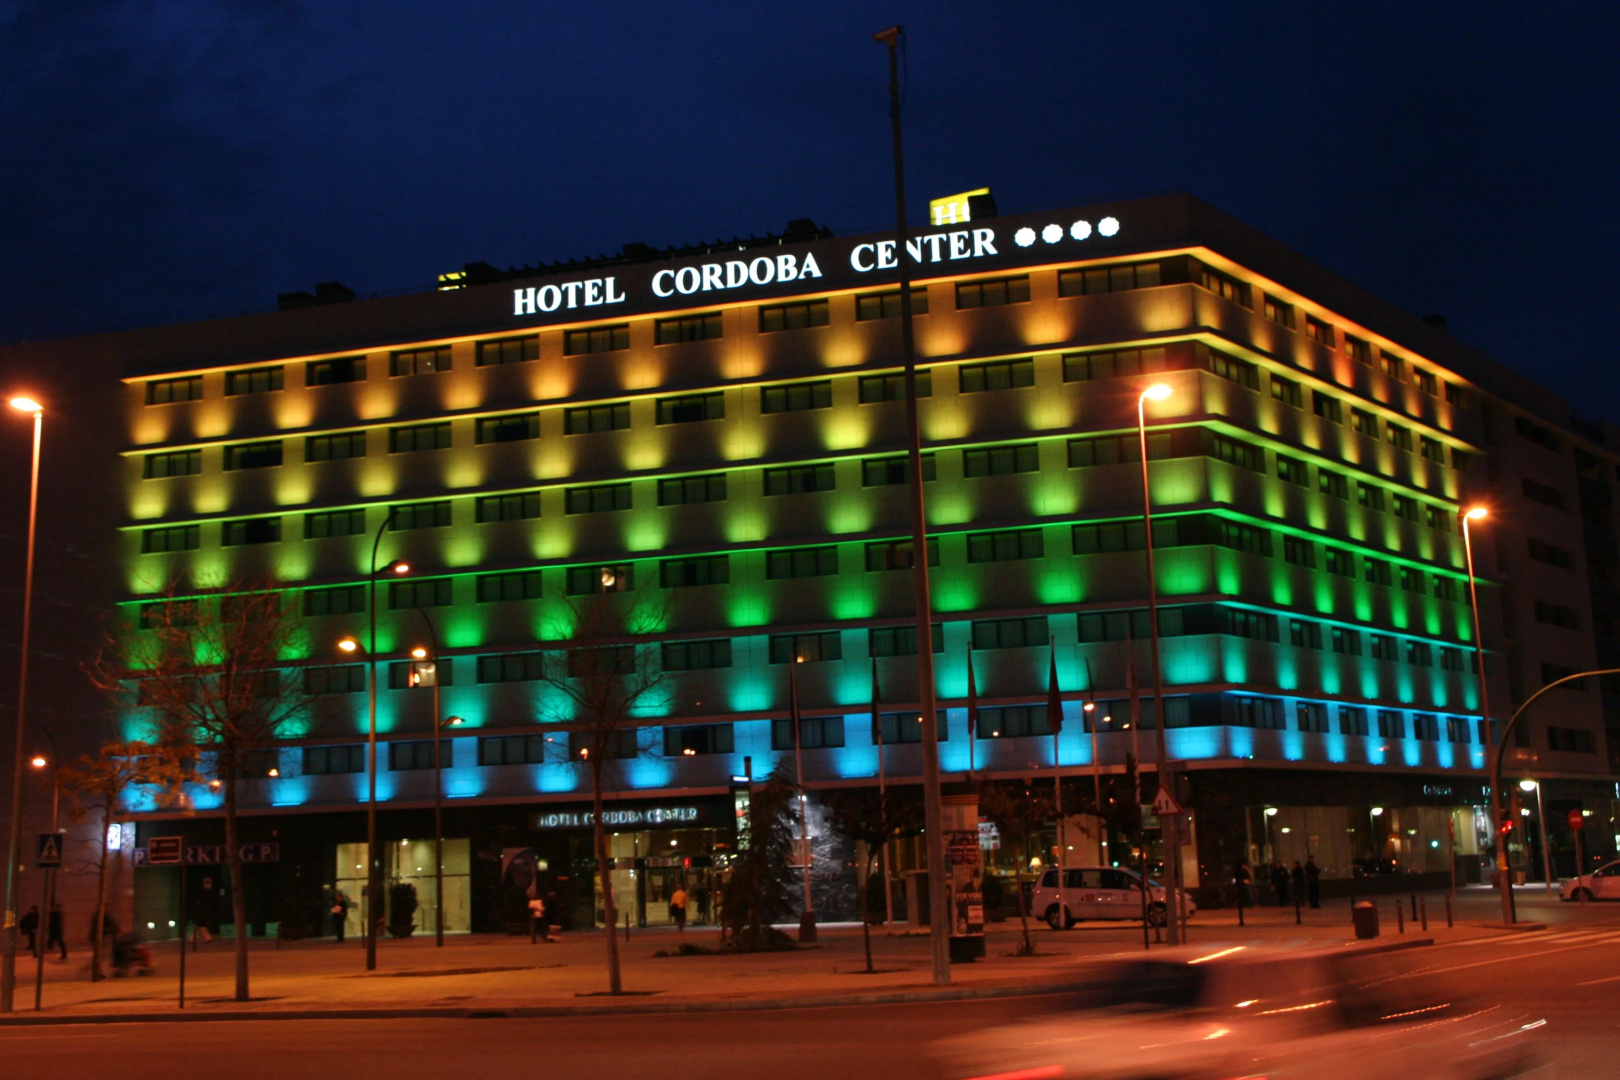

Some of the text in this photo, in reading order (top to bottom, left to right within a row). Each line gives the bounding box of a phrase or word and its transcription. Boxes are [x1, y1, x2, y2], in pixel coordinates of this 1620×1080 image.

[513, 228, 999, 317] HOTEL CORDOBA CENTER
